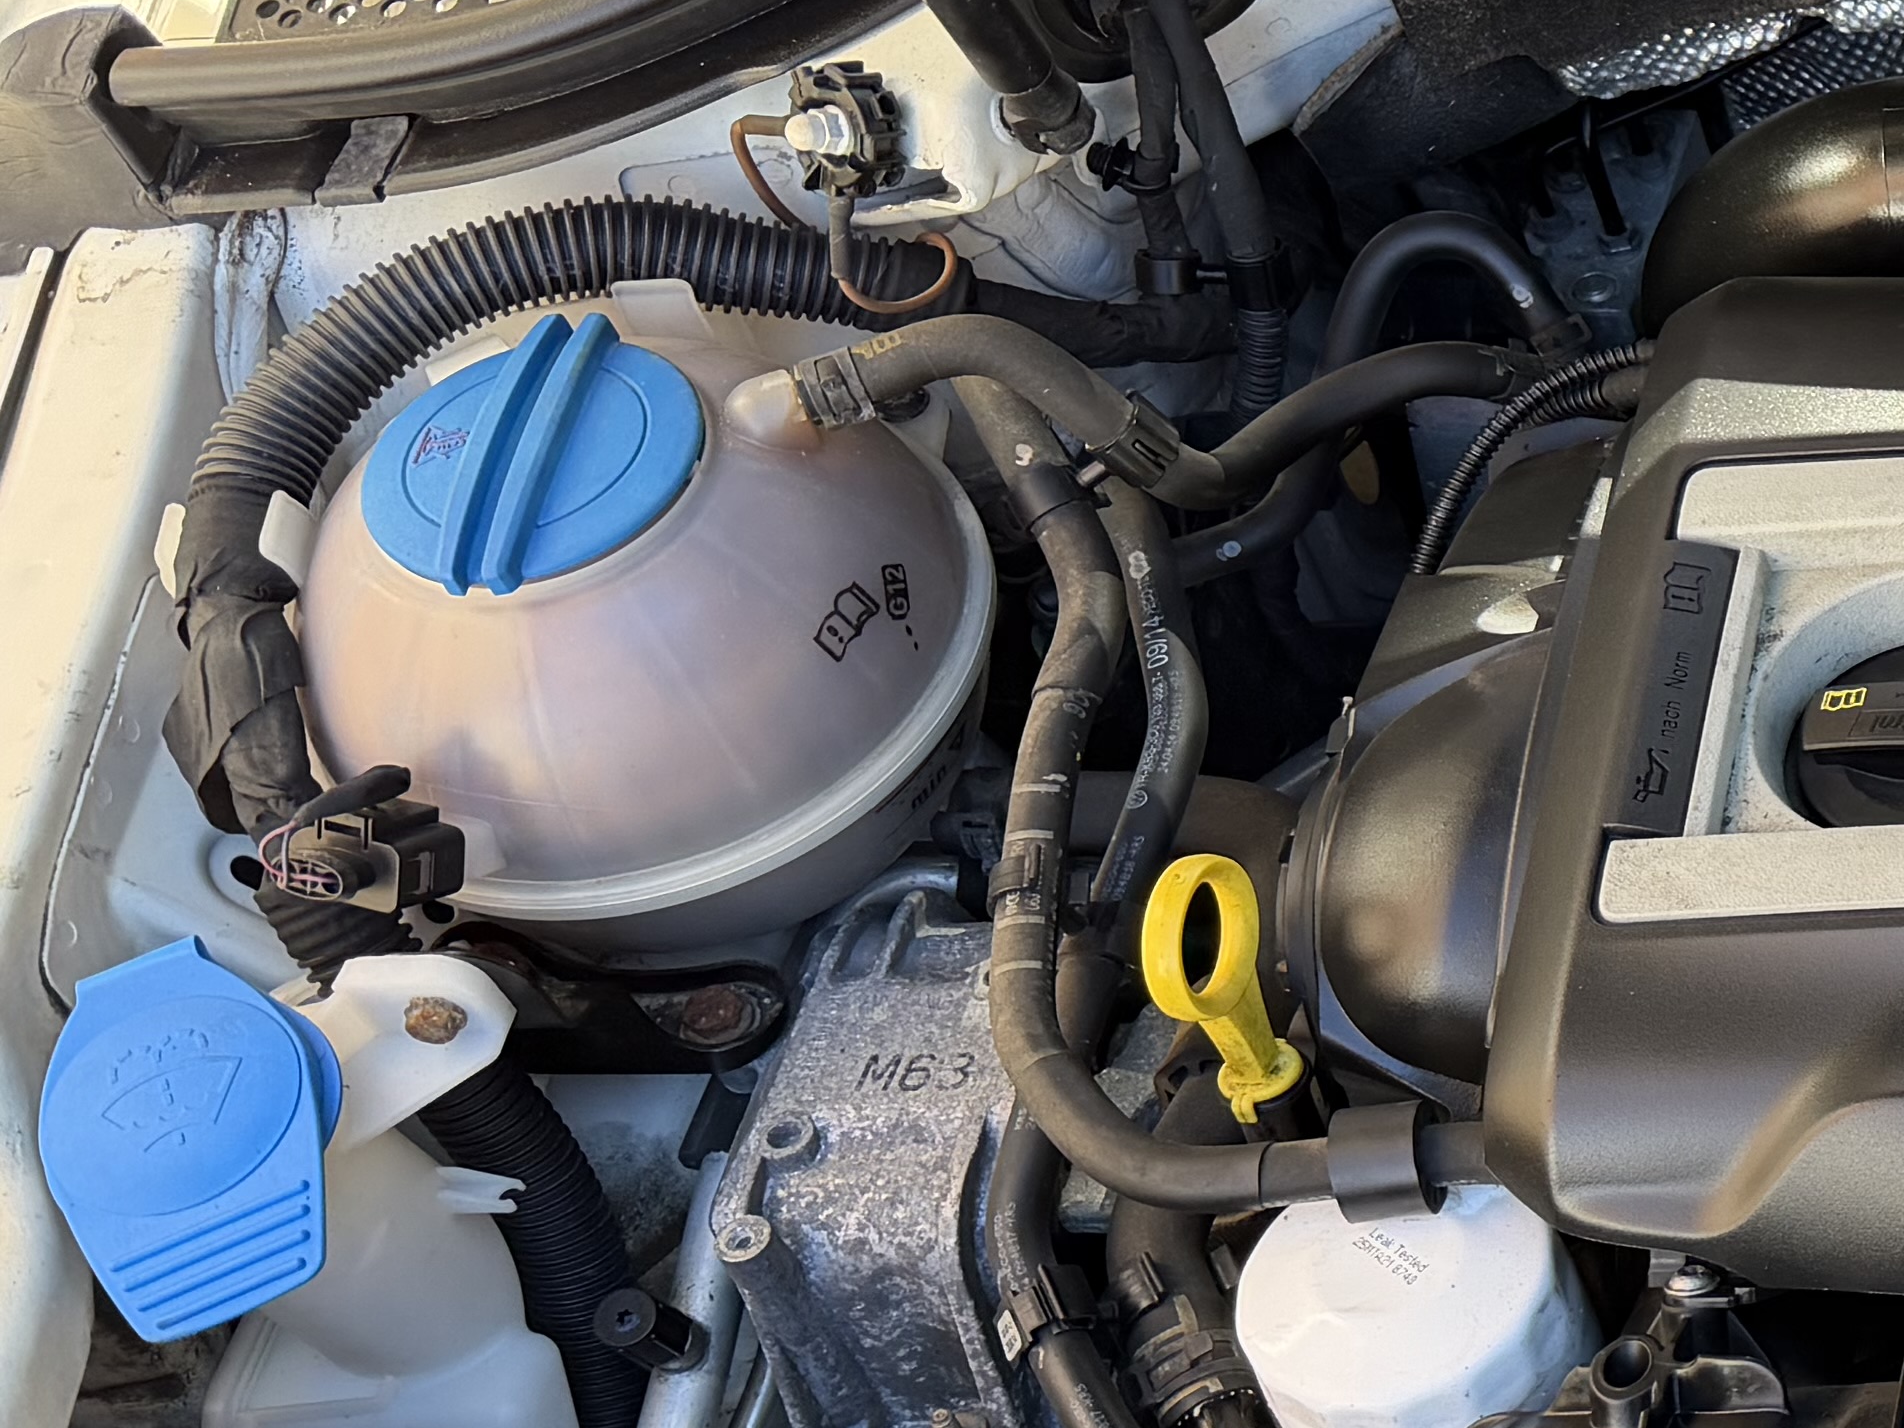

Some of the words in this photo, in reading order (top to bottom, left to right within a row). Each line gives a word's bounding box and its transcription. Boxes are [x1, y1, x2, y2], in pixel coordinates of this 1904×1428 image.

[883, 565, 910, 618] G12
[1664, 651, 1692, 690] Norm
[1661, 700, 1681, 739] nach
[911, 765, 947, 810] min
[854, 1053, 976, 1092] M63
[1394, 1243, 1430, 1273] Tested
